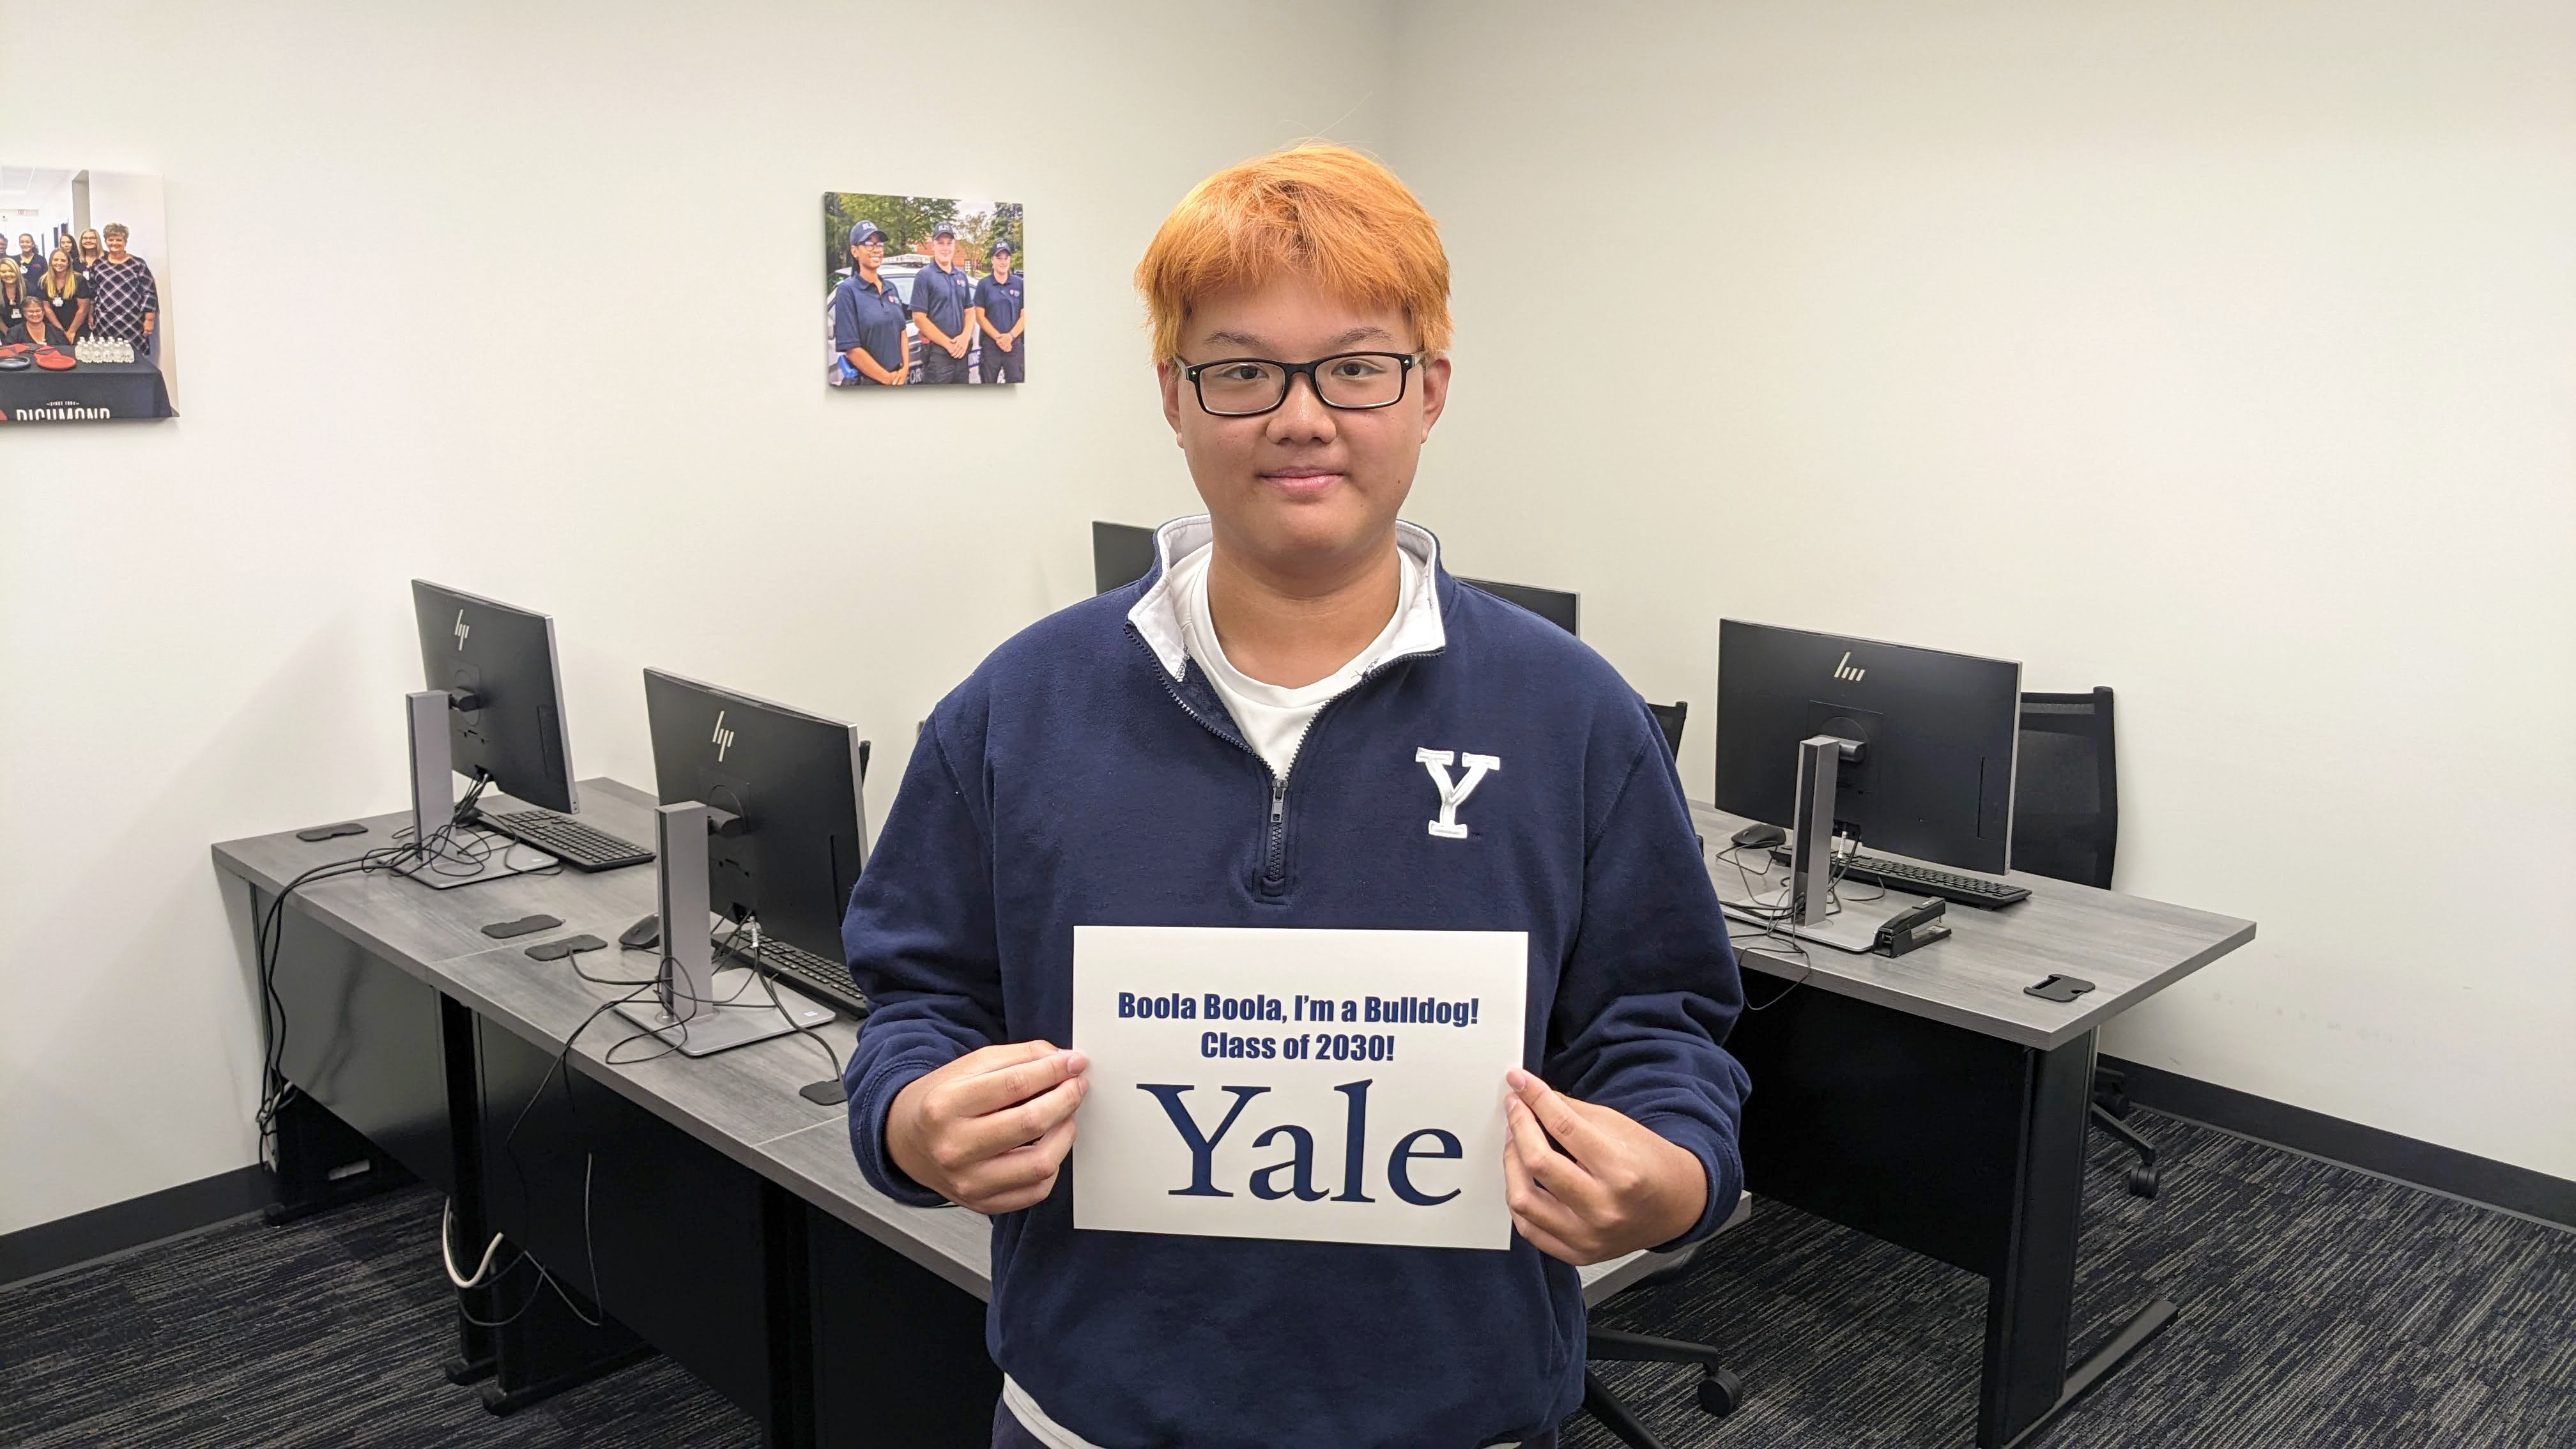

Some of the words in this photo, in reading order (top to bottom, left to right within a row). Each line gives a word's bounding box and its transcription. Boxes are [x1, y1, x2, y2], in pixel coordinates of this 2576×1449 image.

[454, 609, 470, 651] hp
[712, 710, 735, 762] hp
[1415, 746, 1501, 839] Y
[1118, 992, 1196, 1020] Boola
[1204, 993, 1287, 1023] Boola,
[1294, 995, 1334, 1022] I’m
[1341, 1000, 1357, 1022] a
[1364, 996, 1479, 1027] Bulldog!
[1201, 1031, 1276, 1059] Class
[1283, 1034, 1310, 1060] of
[1315, 1034, 1395, 1061] 2030!
[1136, 1078, 1463, 1206] Yale
